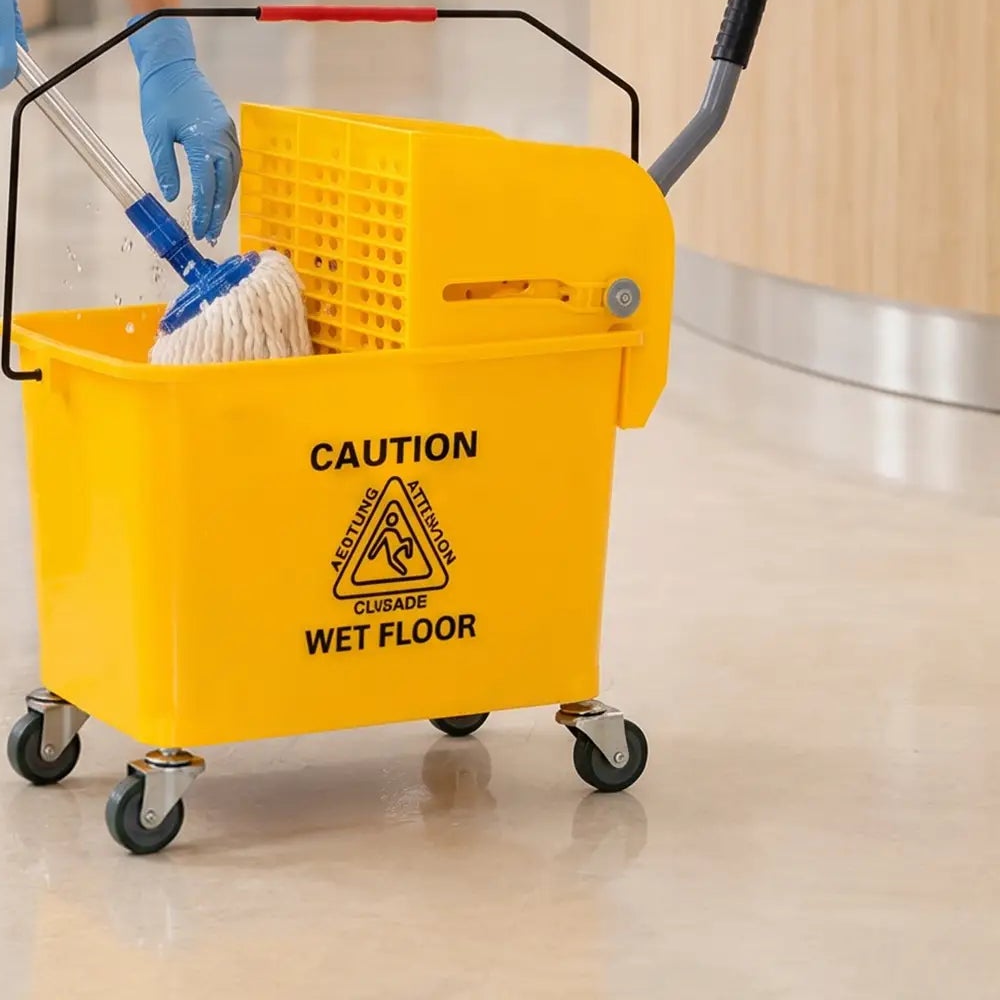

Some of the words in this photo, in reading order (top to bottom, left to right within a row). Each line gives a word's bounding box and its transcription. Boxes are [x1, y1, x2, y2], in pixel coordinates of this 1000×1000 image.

[310, 430, 478, 471] CAUTION
[304, 625, 371, 655] WET
[378, 613, 476, 648] FLOOR
